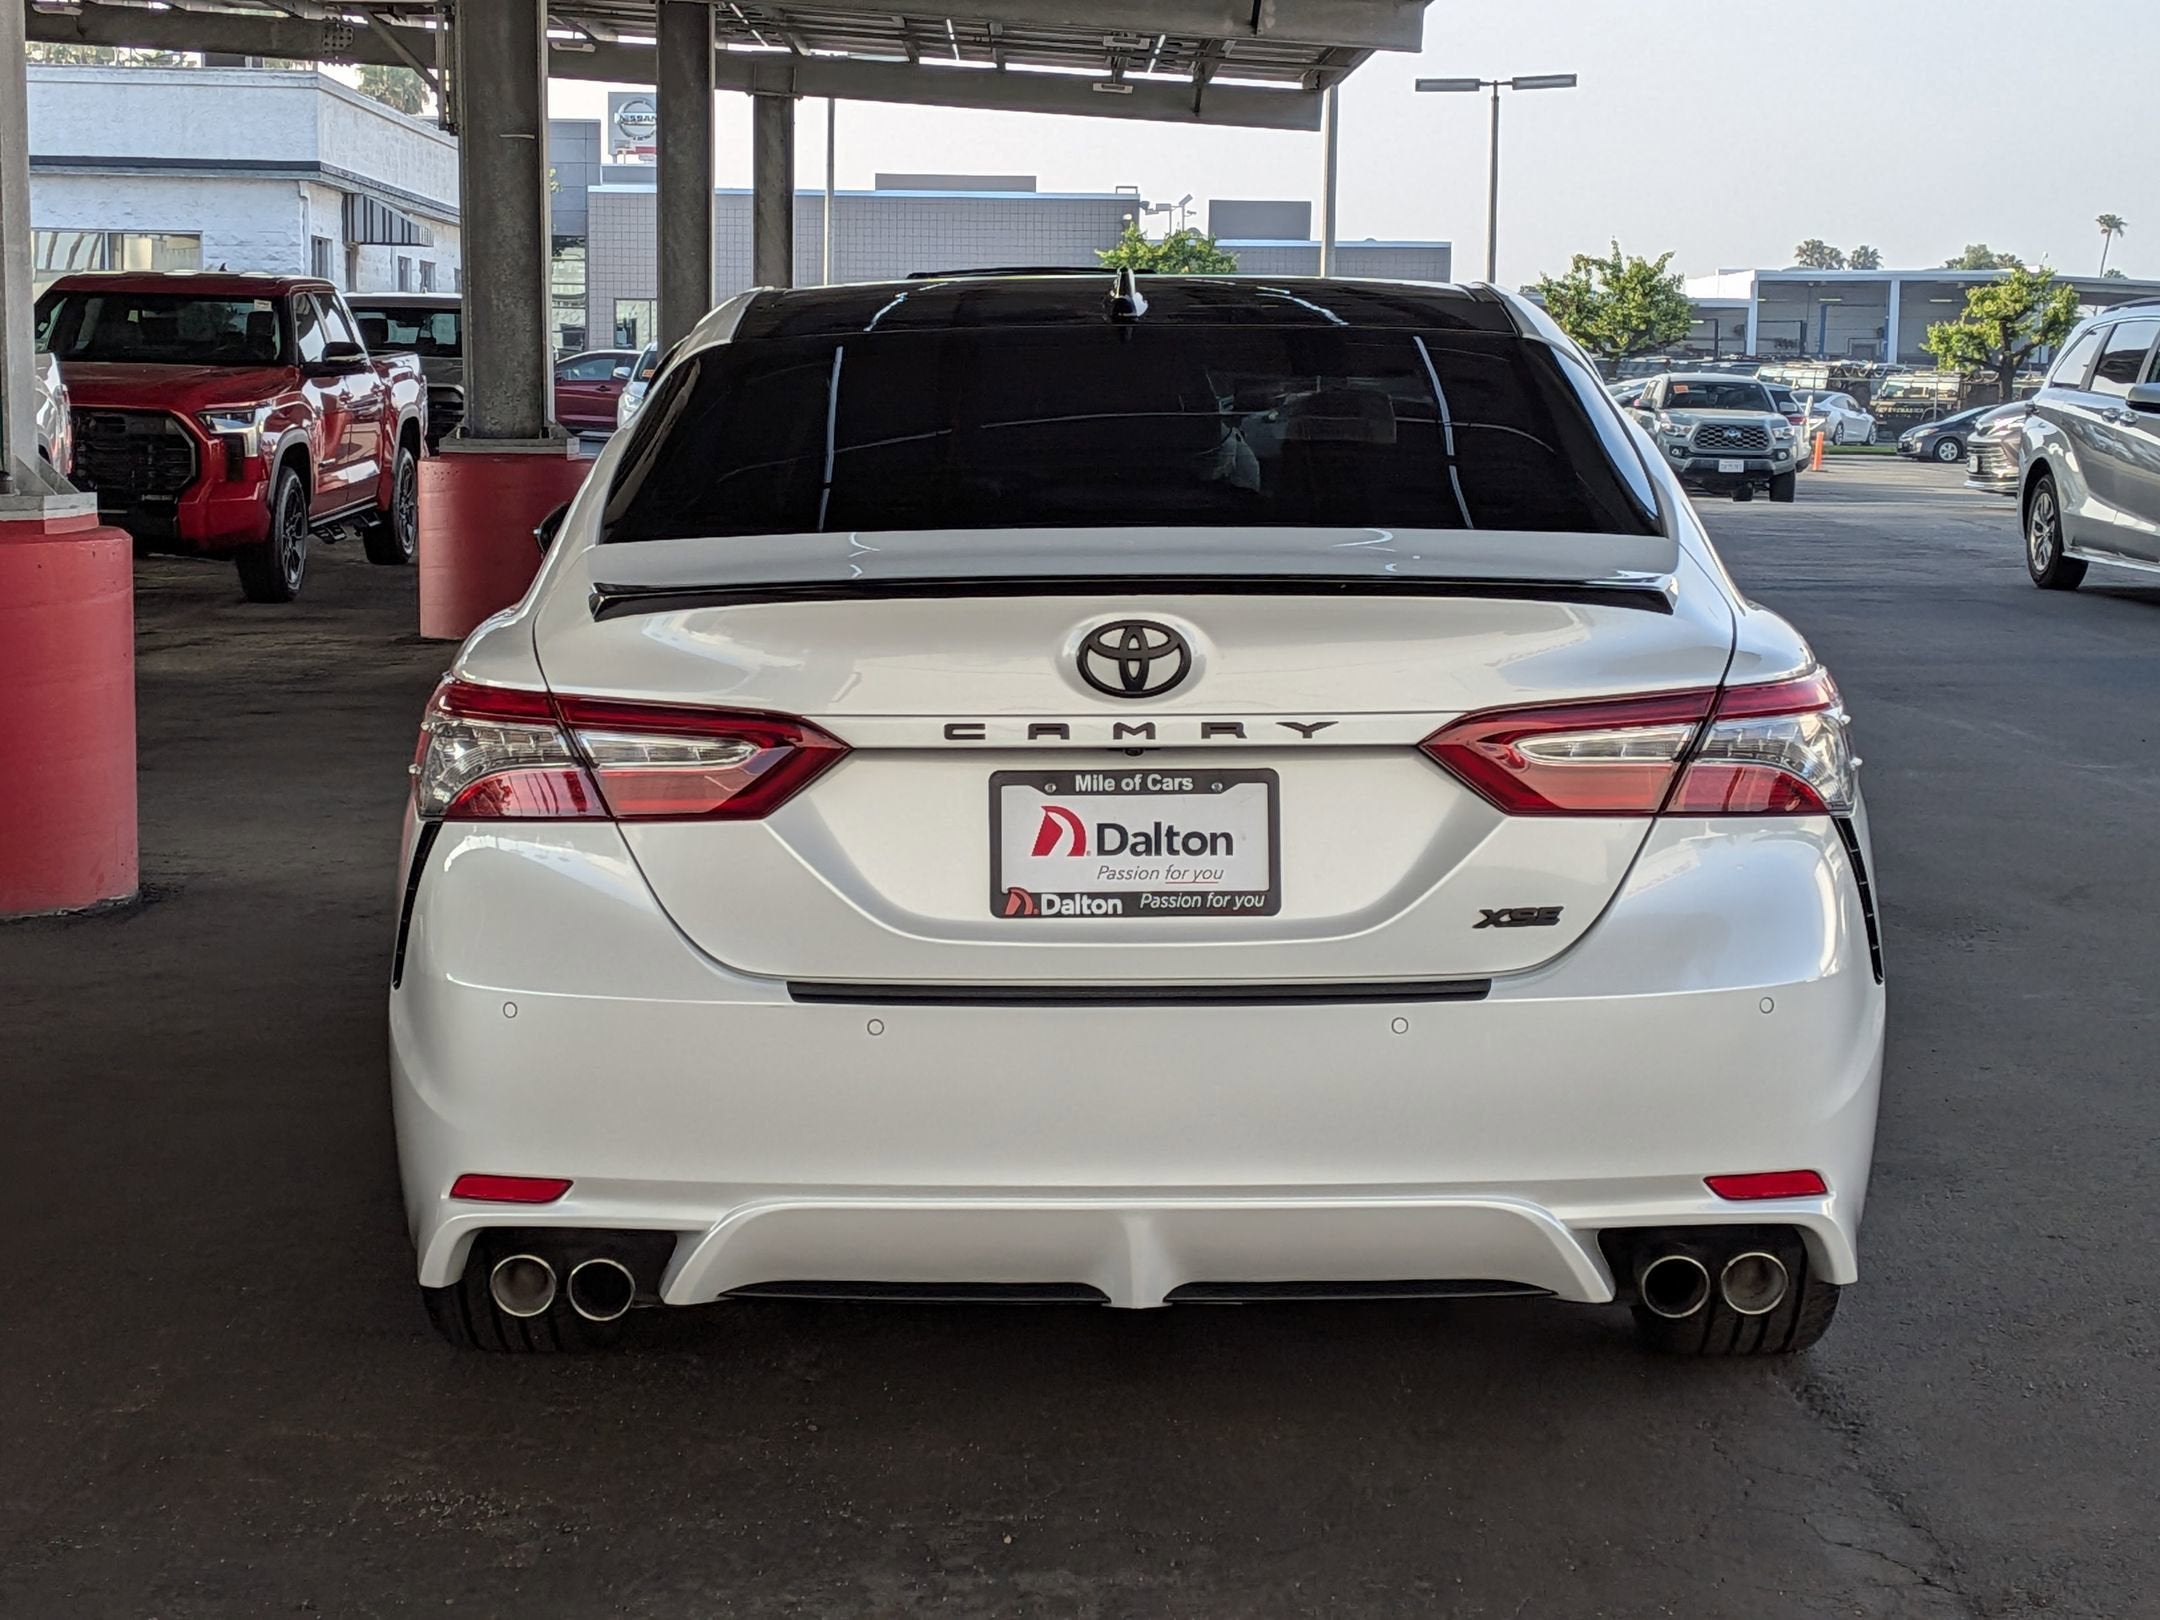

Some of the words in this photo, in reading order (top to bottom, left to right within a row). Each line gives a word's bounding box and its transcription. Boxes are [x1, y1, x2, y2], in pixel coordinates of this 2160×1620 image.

[944, 721, 1339, 740] CAMRY
[1075, 774, 1117, 792] Mile
[1121, 773, 1143, 791] of
[1146, 773, 1194, 791] Cars
[1096, 821, 1233, 857] Dalton
[1097, 865, 1160, 881] Passion
[1165, 864, 1189, 881] for
[1192, 868, 1224, 883] you
[1041, 893, 1123, 915] Dalton
[1140, 892, 1202, 909] Passion
[1206, 892, 1230, 908] for
[1233, 894, 1265, 911] you
[1472, 906, 1564, 929] XSE
